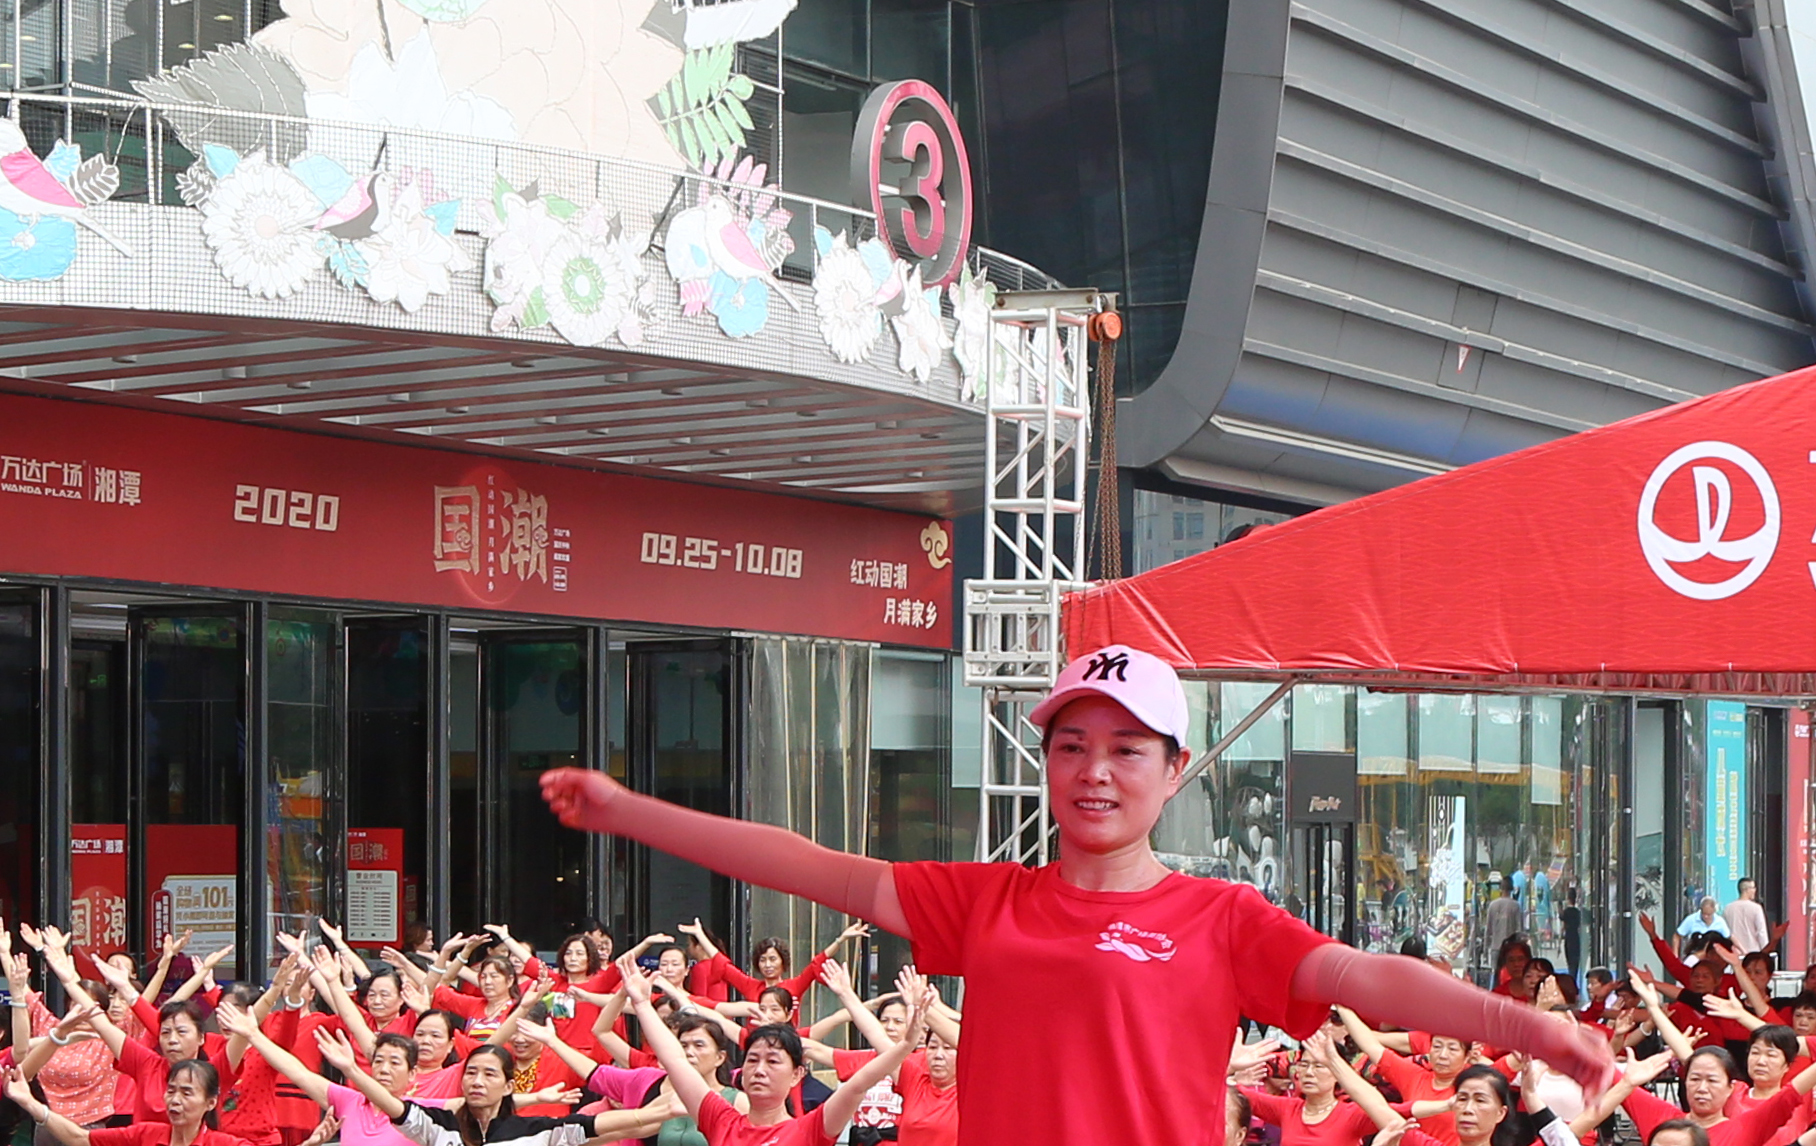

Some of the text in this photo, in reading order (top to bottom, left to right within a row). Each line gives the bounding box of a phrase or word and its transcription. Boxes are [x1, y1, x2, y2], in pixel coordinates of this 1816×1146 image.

[902, 120, 945, 259] 3
[1, 455, 141, 506] 万达广场 湘潭
[1, 482, 83, 500] WANDA PLAZA
[234, 484, 339, 532] 2020
[640, 532, 803, 579] 09.25-10.08
[850, 558, 908, 590] 红动国潮
[883, 597, 937, 630] 月满家乡
[203, 886, 229, 908] 101
